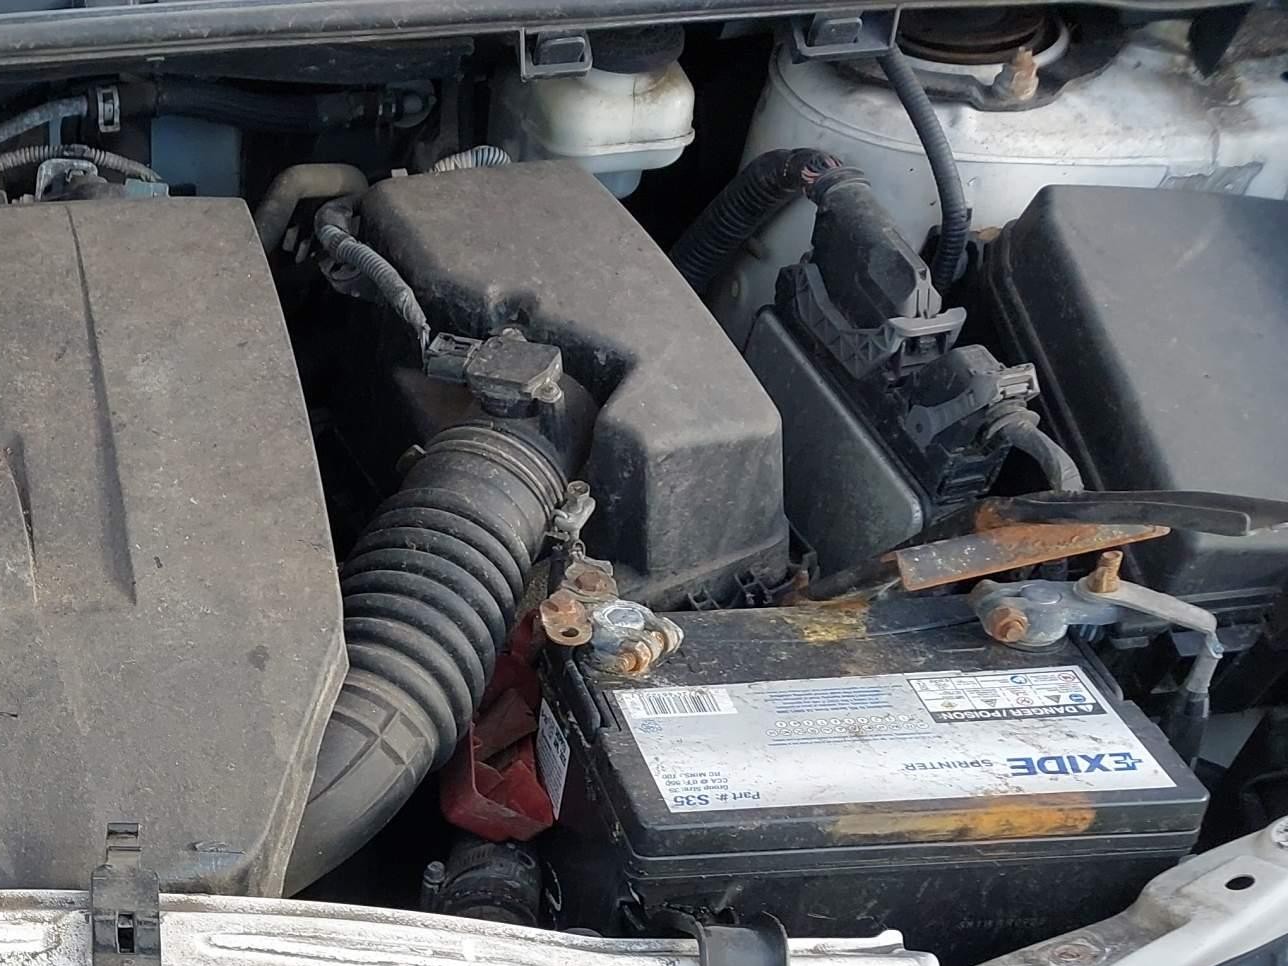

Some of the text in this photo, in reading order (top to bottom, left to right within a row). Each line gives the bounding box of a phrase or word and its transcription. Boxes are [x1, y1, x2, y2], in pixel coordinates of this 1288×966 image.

[903, 752, 1143, 777] EXIDE SPRINTER
[673, 791, 761, 806] Part #: S35
